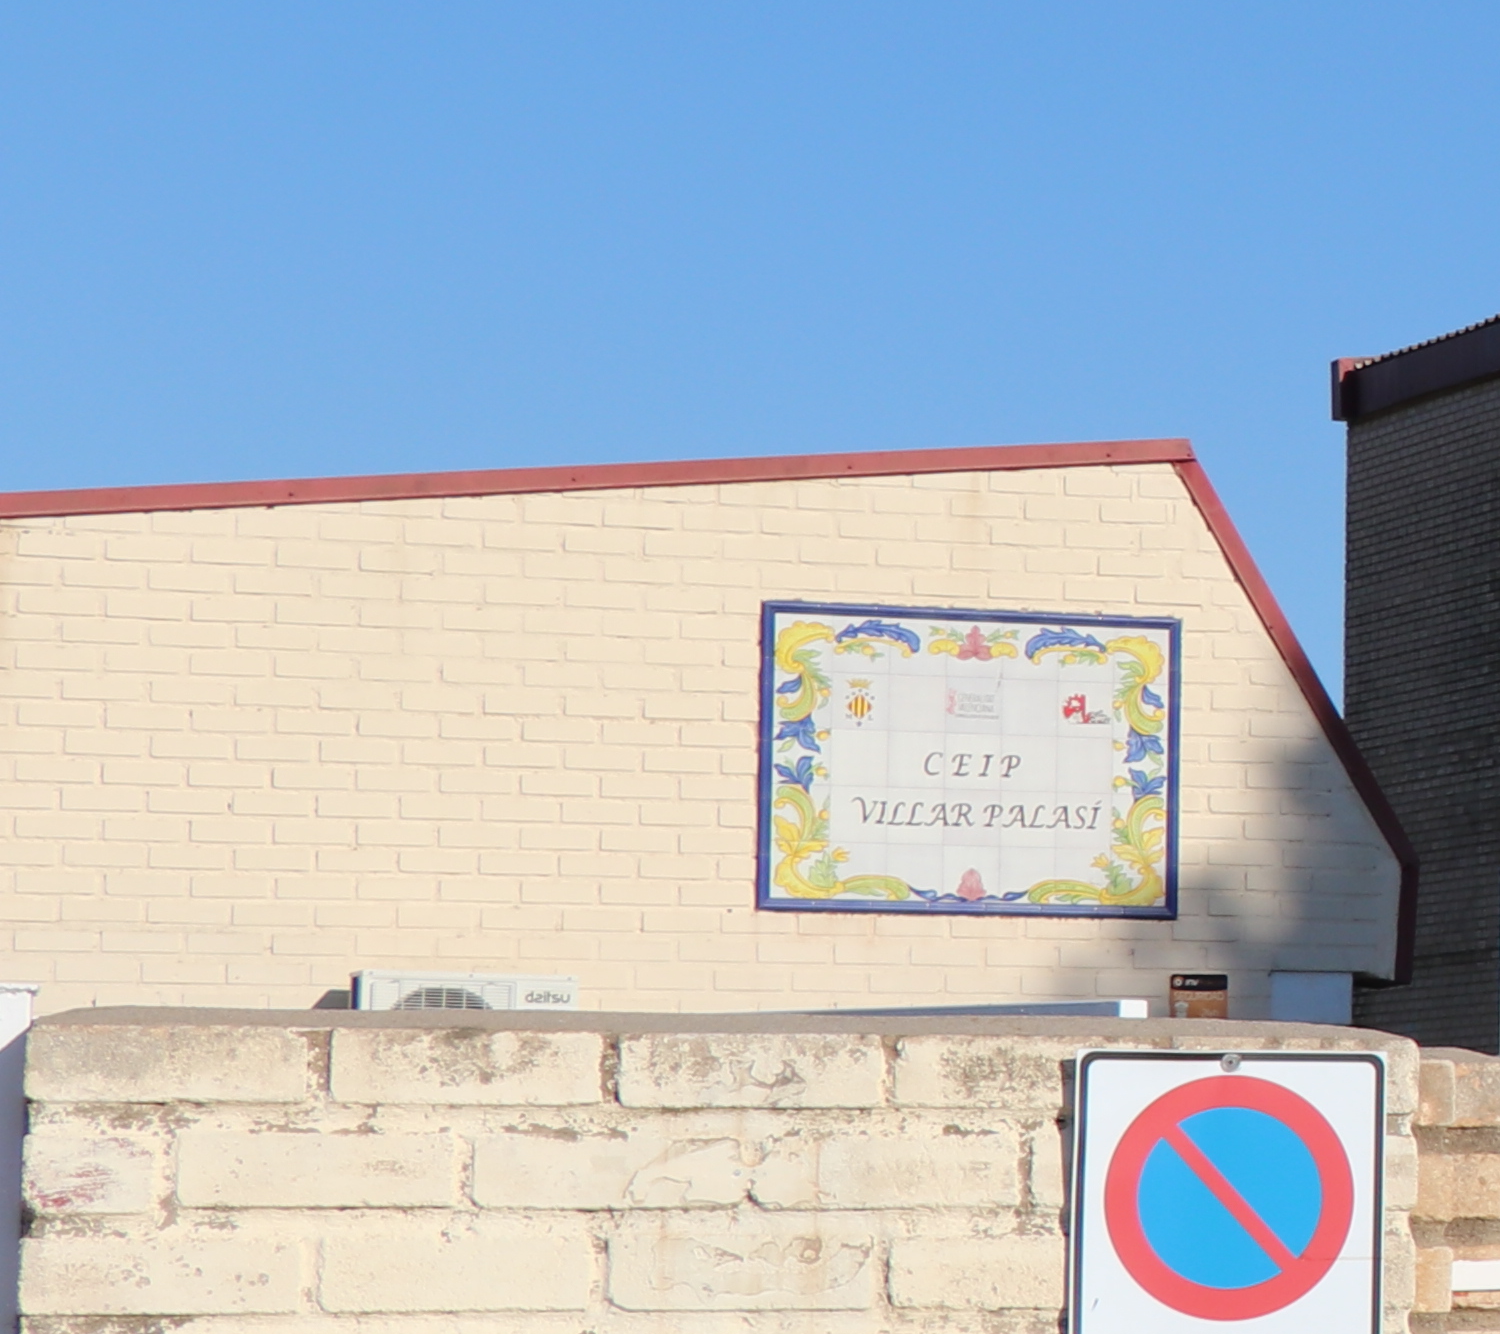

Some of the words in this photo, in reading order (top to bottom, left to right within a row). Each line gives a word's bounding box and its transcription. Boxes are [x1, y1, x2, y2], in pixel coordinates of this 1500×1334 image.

[851, 796, 975, 827] VILLAR
[982, 799, 1103, 830] PALASÍ
[524, 991, 571, 1004] daitsu
